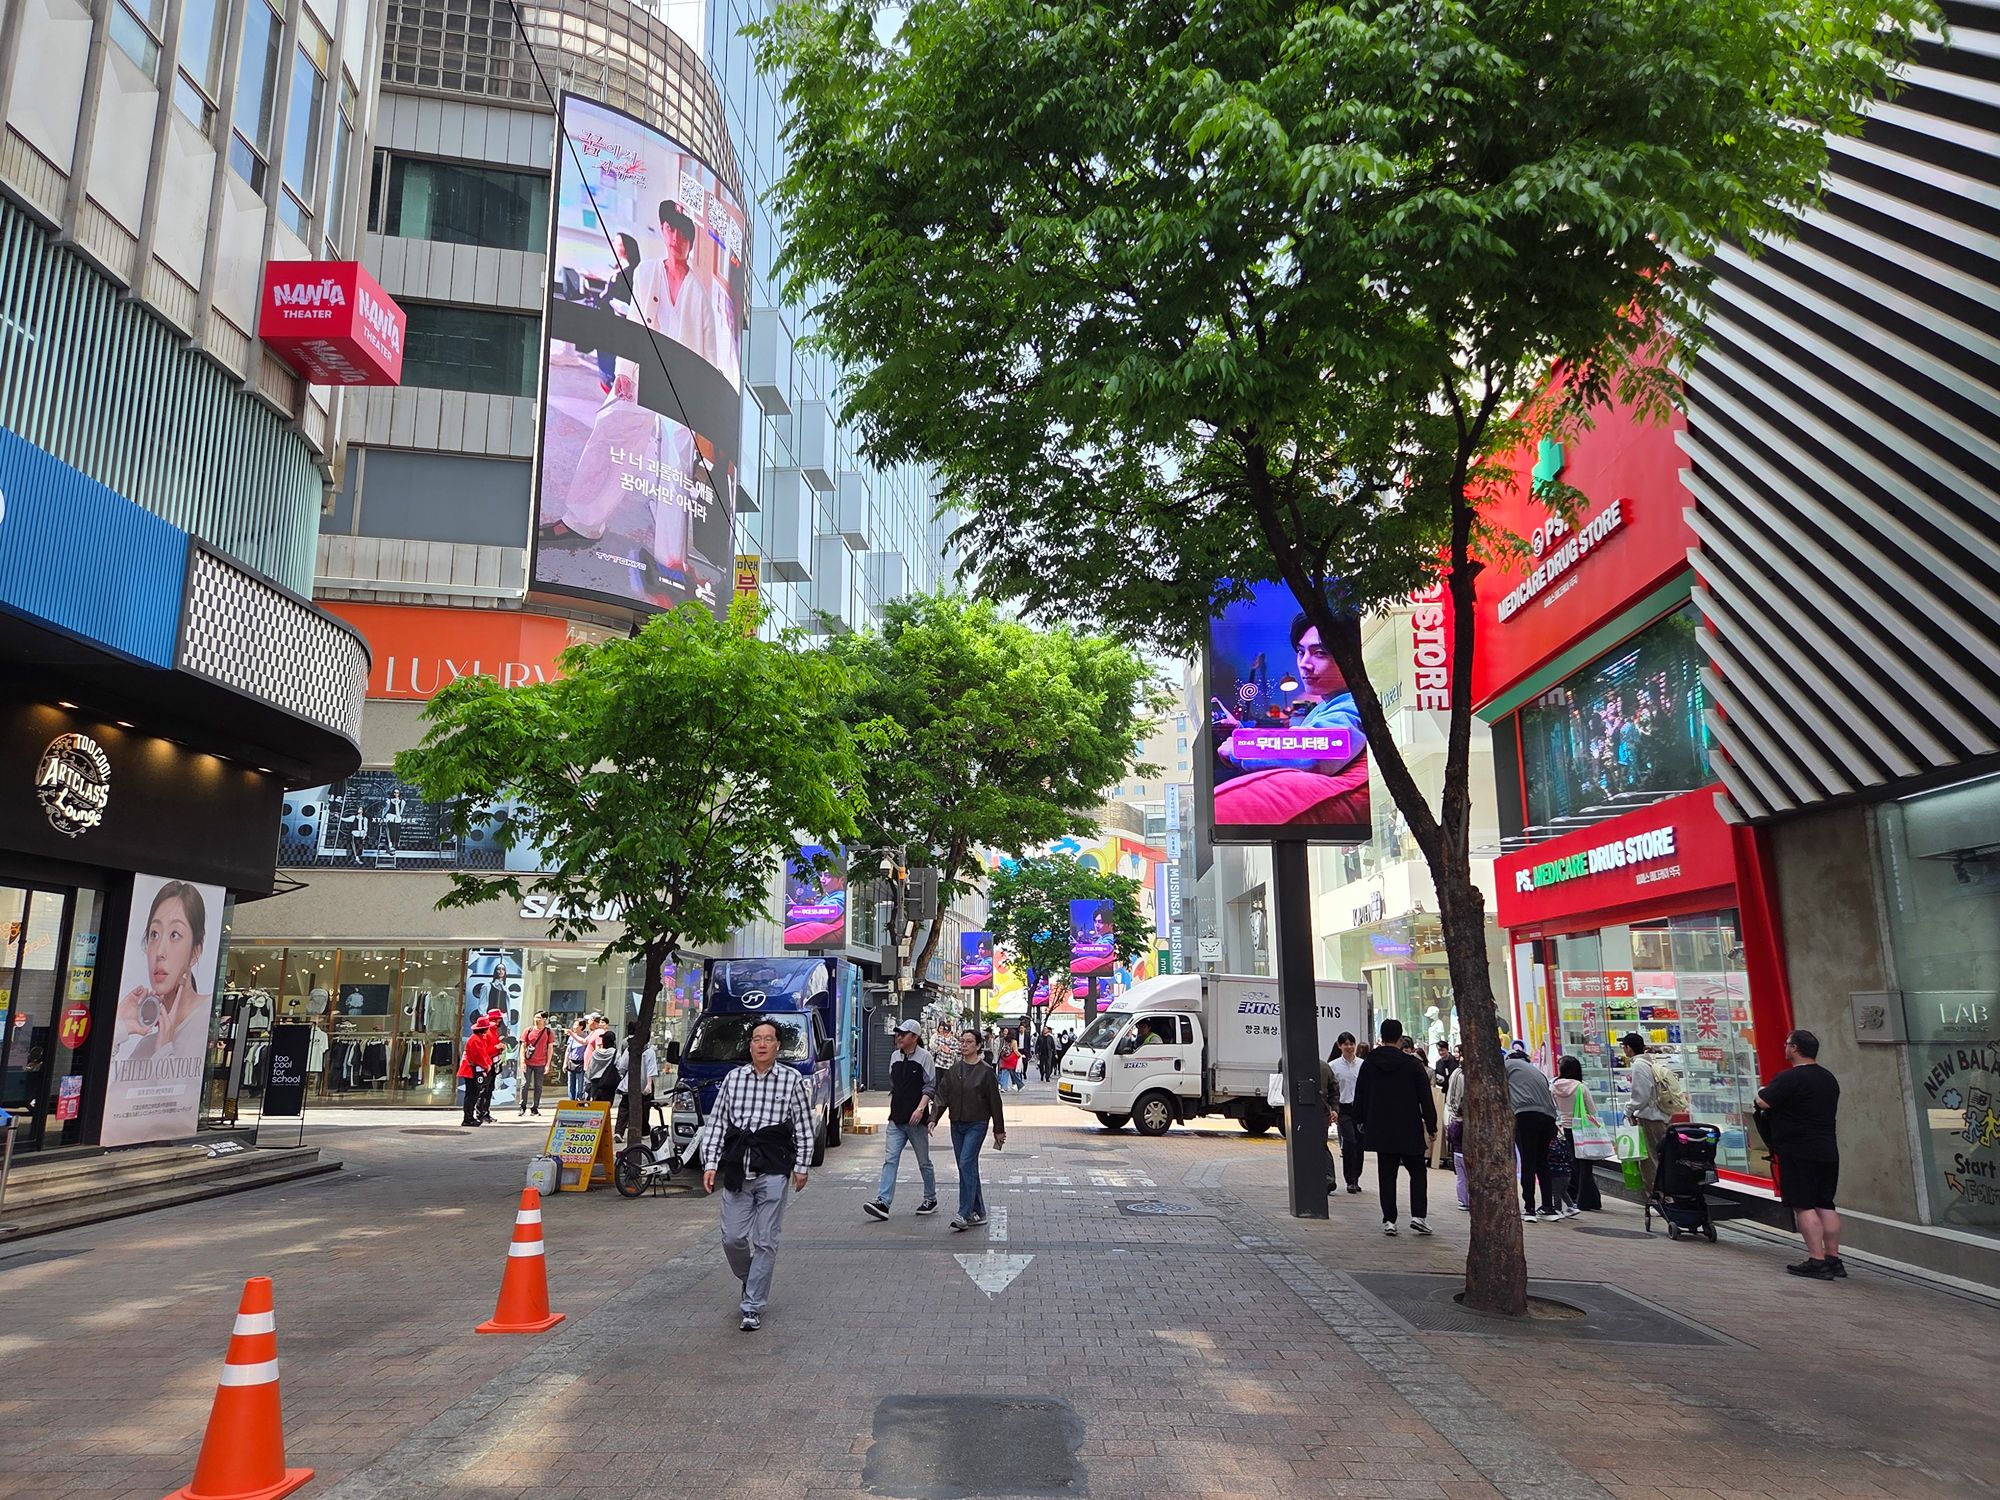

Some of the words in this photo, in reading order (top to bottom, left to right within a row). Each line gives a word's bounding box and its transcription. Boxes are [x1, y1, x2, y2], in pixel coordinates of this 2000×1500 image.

[273, 278, 346, 307] NANTA
[283, 310, 332, 319] THEATER
[358, 287, 400, 355] NANTA
[363, 325, 393, 364] THEATER
[610, 446, 626, 466] 난
[628, 452, 643, 472] 너
[646, 458, 694, 492] 괴롭히는
[695, 480, 714, 506] 애들
[620, 472, 674, 507] 꿈에서만
[676, 494, 708, 524] 아니라
[1497, 564, 1548, 624] MEDICARE
[1546, 537, 1580, 583] DRUG
[1578, 499, 1622, 554] STORE
[1413, 606, 1450, 711] STORE
[1256, 737, 1280, 750] 무대
[1282, 737, 1329, 750] 모니터링
[41, 758, 110, 808] ARTCLASS
[92, 747, 112, 782] COOL
[56, 787, 102, 827] Lounge
[1516, 869, 1533, 892] PS.
[1533, 852, 1588, 887] MEDICARE
[1588, 840, 1626, 874] DRUG
[1625, 826, 1675, 864] STORE
[1170, 868, 1181, 916] MUSINSA
[1172, 926, 1182, 975] MUSINSA
[62, 1017, 88, 1038] 1+1
[112, 1059, 153, 1081] VEILED
[155, 1057, 203, 1080] CONTOUR
[271, 1075, 300, 1083] school
[272, 1068, 285, 1076] for
[273, 1060, 293, 1069] cool
[1923, 1053, 1955, 1100] NEW
[1954, 1153, 1997, 1179] Start
